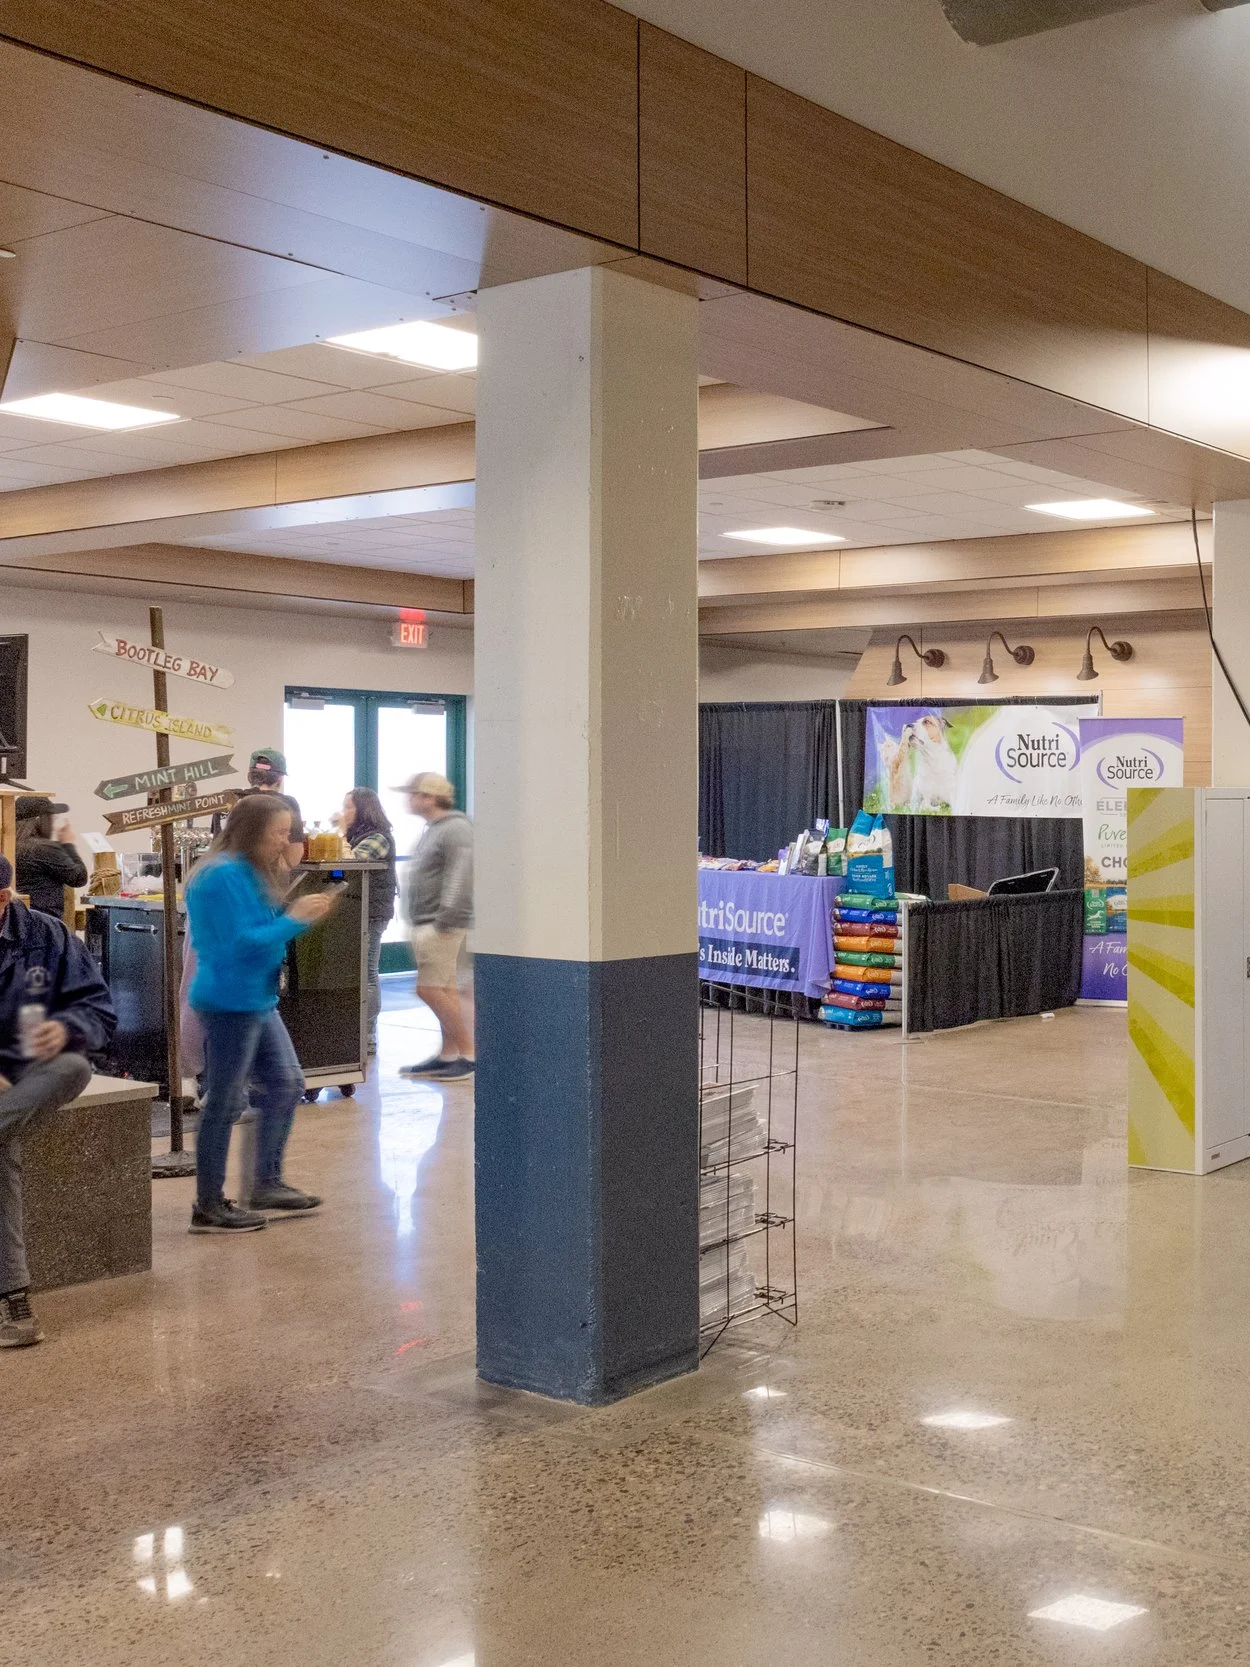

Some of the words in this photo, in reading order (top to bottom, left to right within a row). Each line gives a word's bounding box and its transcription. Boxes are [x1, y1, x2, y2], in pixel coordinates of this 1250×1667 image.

[400, 623, 424, 645] EXIT
[115, 638, 182, 672] BOOTLEG
[187, 660, 218, 682] BAY
[110, 705, 161, 730] CITRUS
[164, 719, 213, 739] ISLAND
[1017, 733, 1060, 751] Nutri
[1006, 748, 1067, 769] Source
[1116, 756, 1148, 768] Nutri
[135, 768, 177, 791] MINT
[184, 760, 220, 781] HILL
[1107, 765, 1154, 780] Source
[122, 800, 191, 825] REFRESHMINT
[195, 794, 225, 809] POINT
[986, 794, 999, 805] A
[1000, 794, 1031, 808] Family
[1031, 794, 1049, 806] Like
[1049, 794, 1063, 806] No
[1096, 800, 1127, 811] ELE
[698, 900, 786, 937] triSource
[1089, 940, 1104, 954] A
[707, 944, 743, 968] Inside
[745, 949, 796, 974] Matters.
[1103, 962, 1119, 978] No
